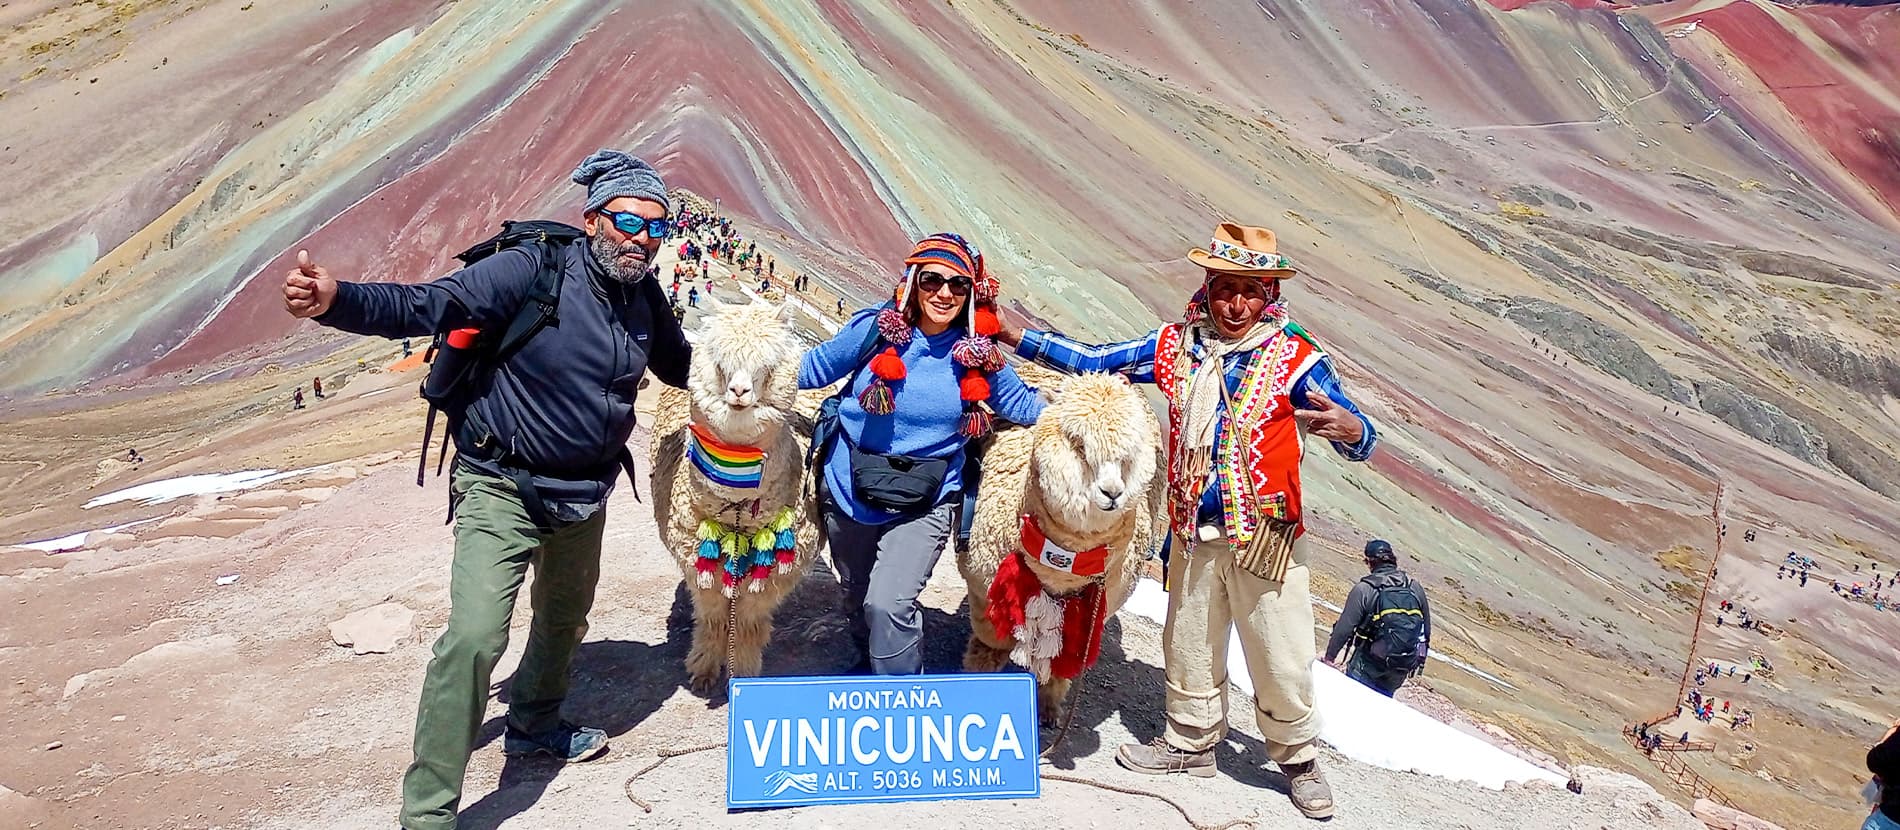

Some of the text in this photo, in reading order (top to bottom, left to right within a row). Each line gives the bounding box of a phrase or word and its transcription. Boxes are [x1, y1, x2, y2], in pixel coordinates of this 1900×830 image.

[828, 685, 942, 711] MONTAÑA
[743, 713, 1025, 768] VINICUNCA
[823, 767, 1006, 791] ALT. 5036 M.S.N.M.
